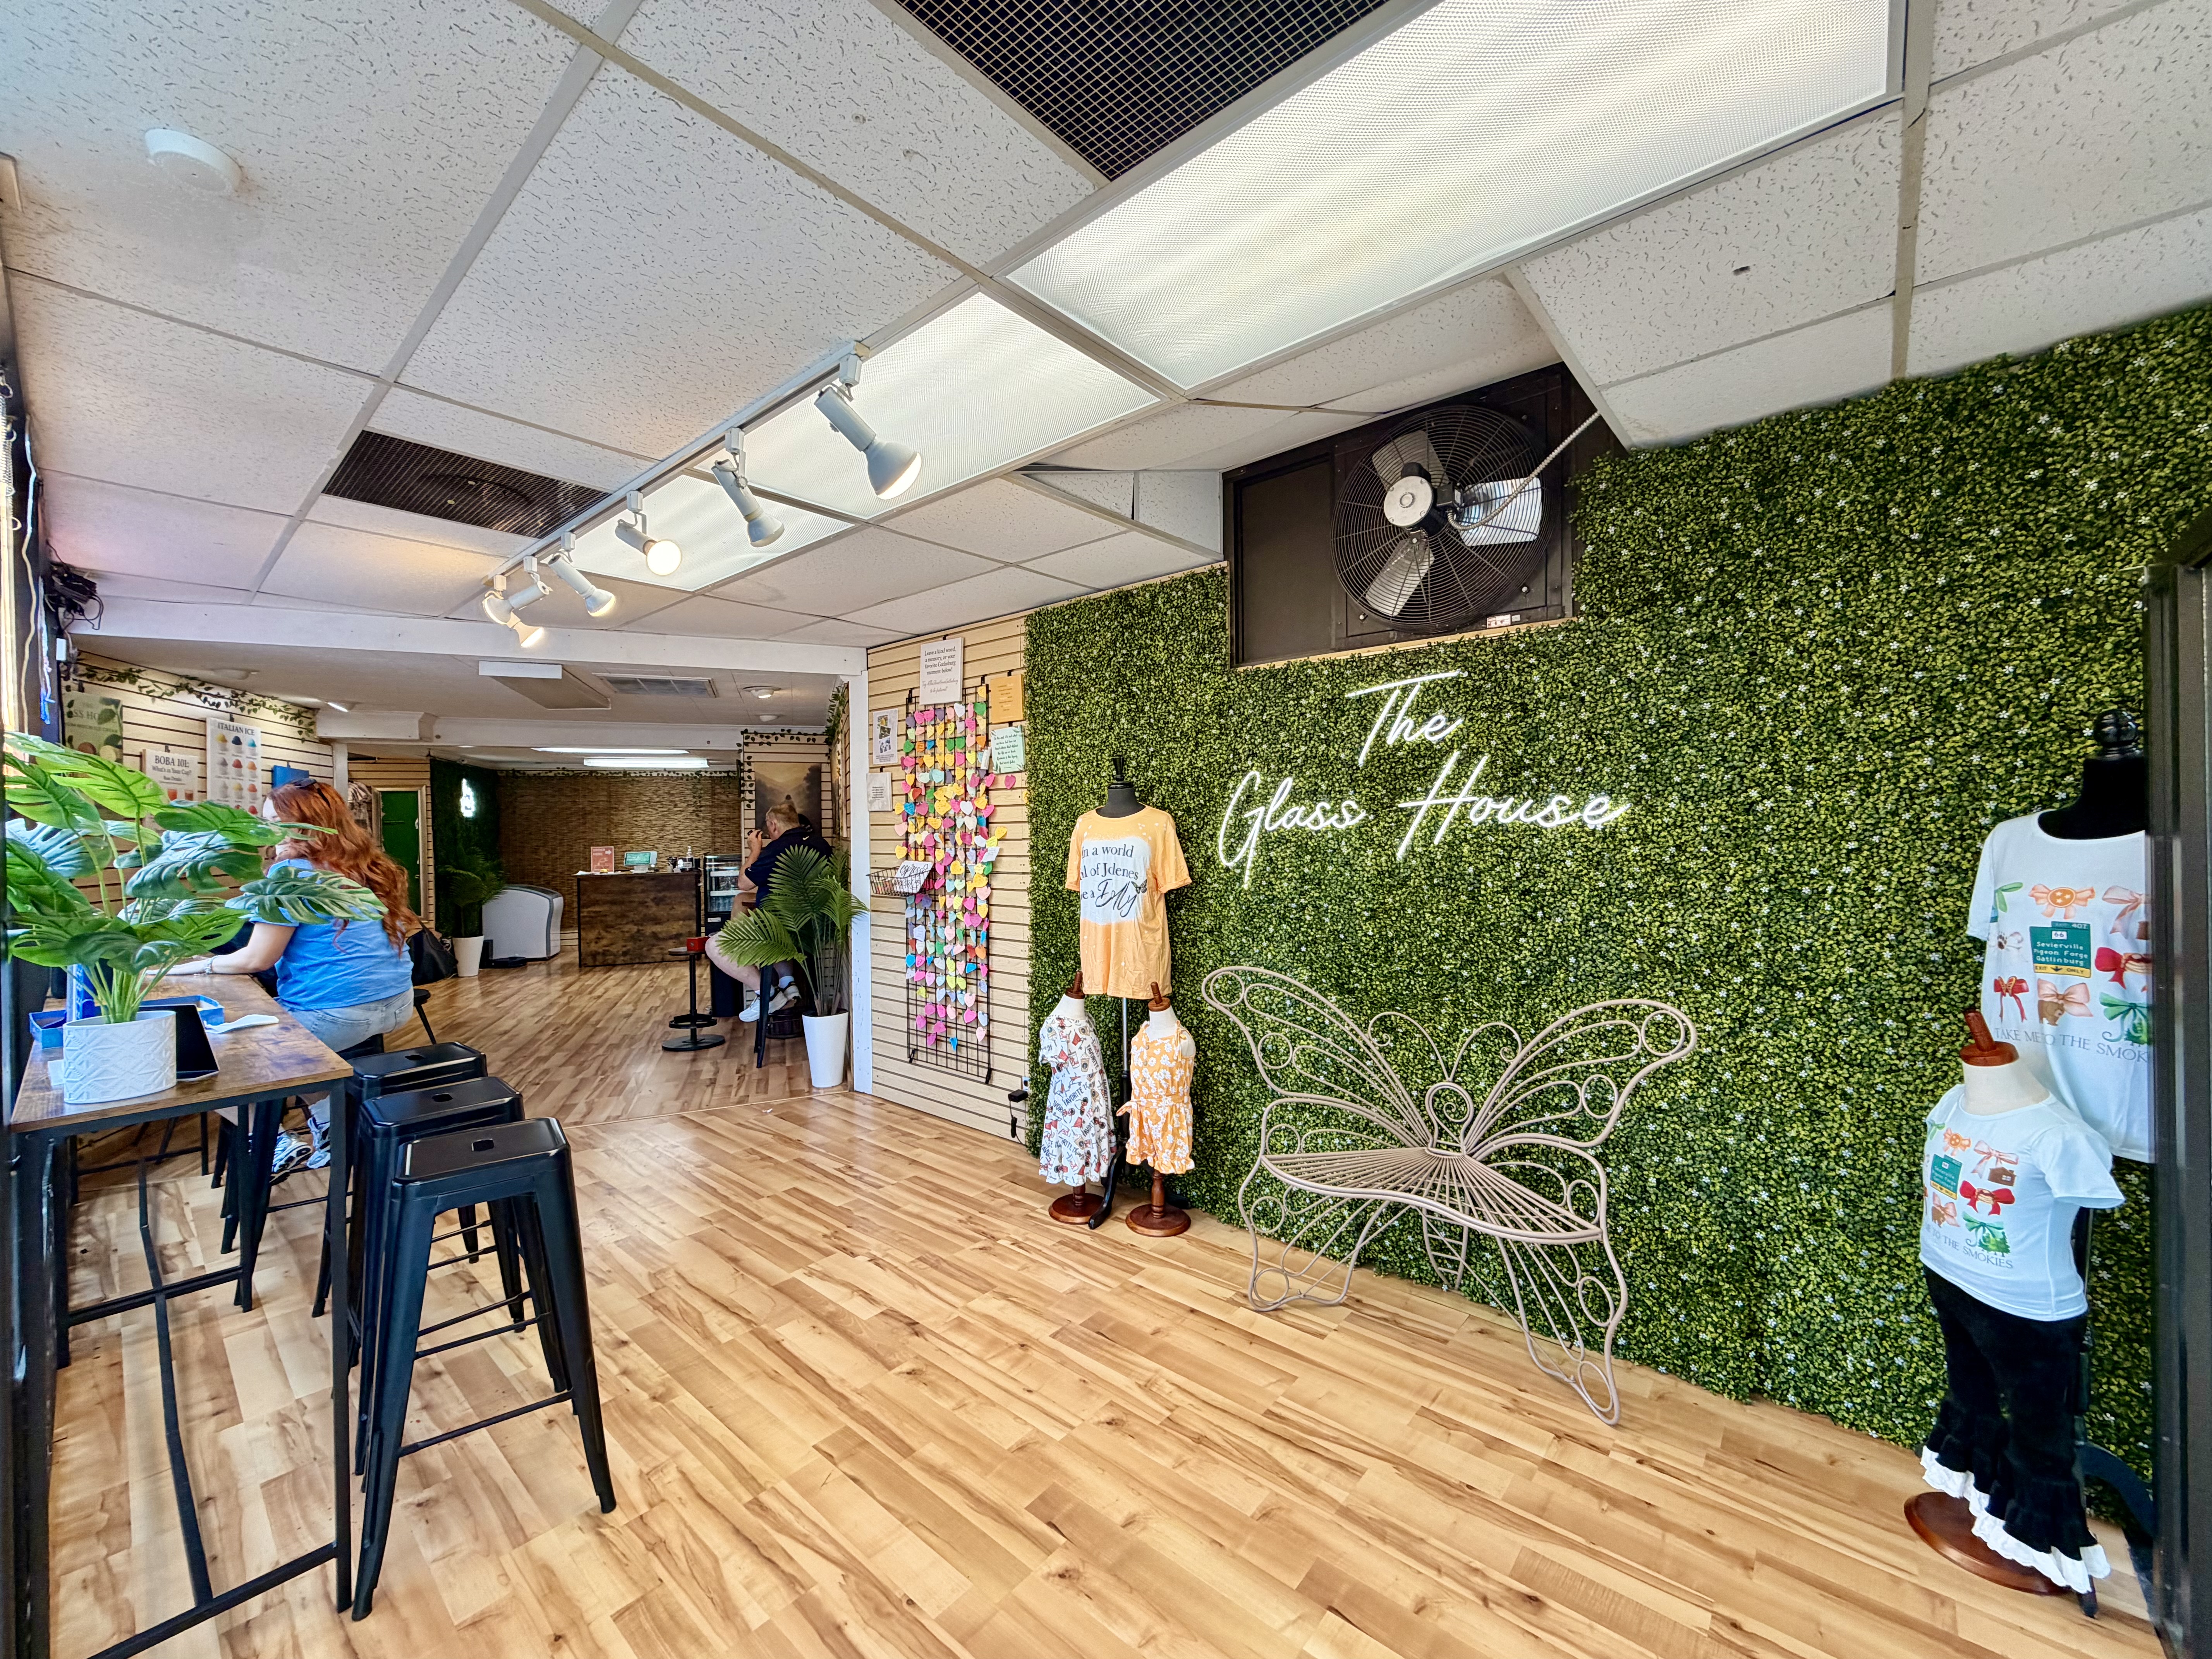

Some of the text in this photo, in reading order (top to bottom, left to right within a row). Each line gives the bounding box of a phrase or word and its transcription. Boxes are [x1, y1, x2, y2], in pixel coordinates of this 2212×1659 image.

[1345, 669, 1468, 766] The
[218, 722, 255, 736] ITALIAN ICE
[155, 755, 189, 768] BOBA 101:
[1218, 751, 1631, 889] Glass House
[1092, 847, 1099, 856] a
[1102, 844, 1134, 858] world
[1090, 863, 1101, 876] of
[1081, 891, 1089, 900] e
[1090, 890, 1095, 898] a
[2036, 941, 2084, 950] Sevierville
[2036, 956, 2084, 967] Gatlinburg
[1994, 1027, 2148, 1063] TAKE ME O THE SMOK
[1942, 1235, 1960, 1251] THE
[1963, 1246, 2014, 1269] SMOKIES
